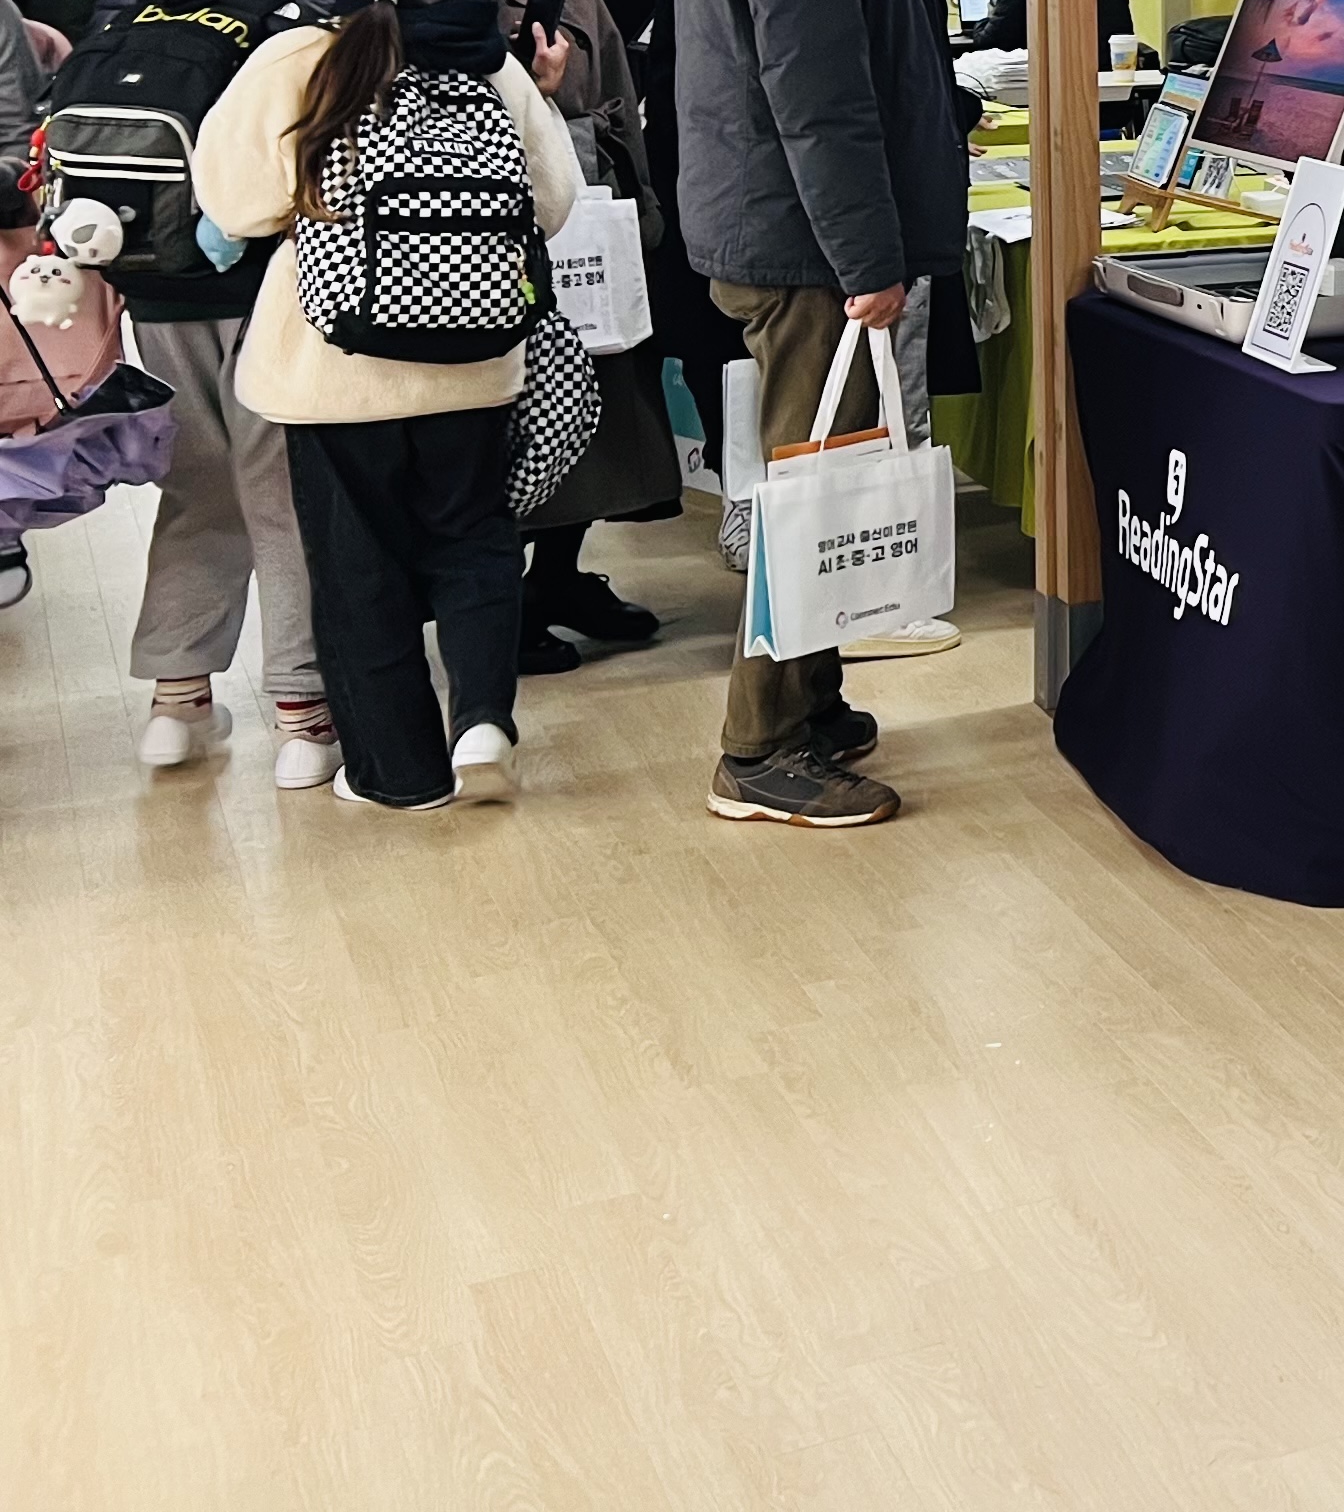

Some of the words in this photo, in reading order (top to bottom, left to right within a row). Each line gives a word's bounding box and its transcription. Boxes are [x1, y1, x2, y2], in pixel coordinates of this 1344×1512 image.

[412, 140, 474, 156] FLAKIKI
[818, 557, 832, 576] AI
[890, 537, 918, 558] 영어
[1118, 489, 1240, 626] ReadingStar
